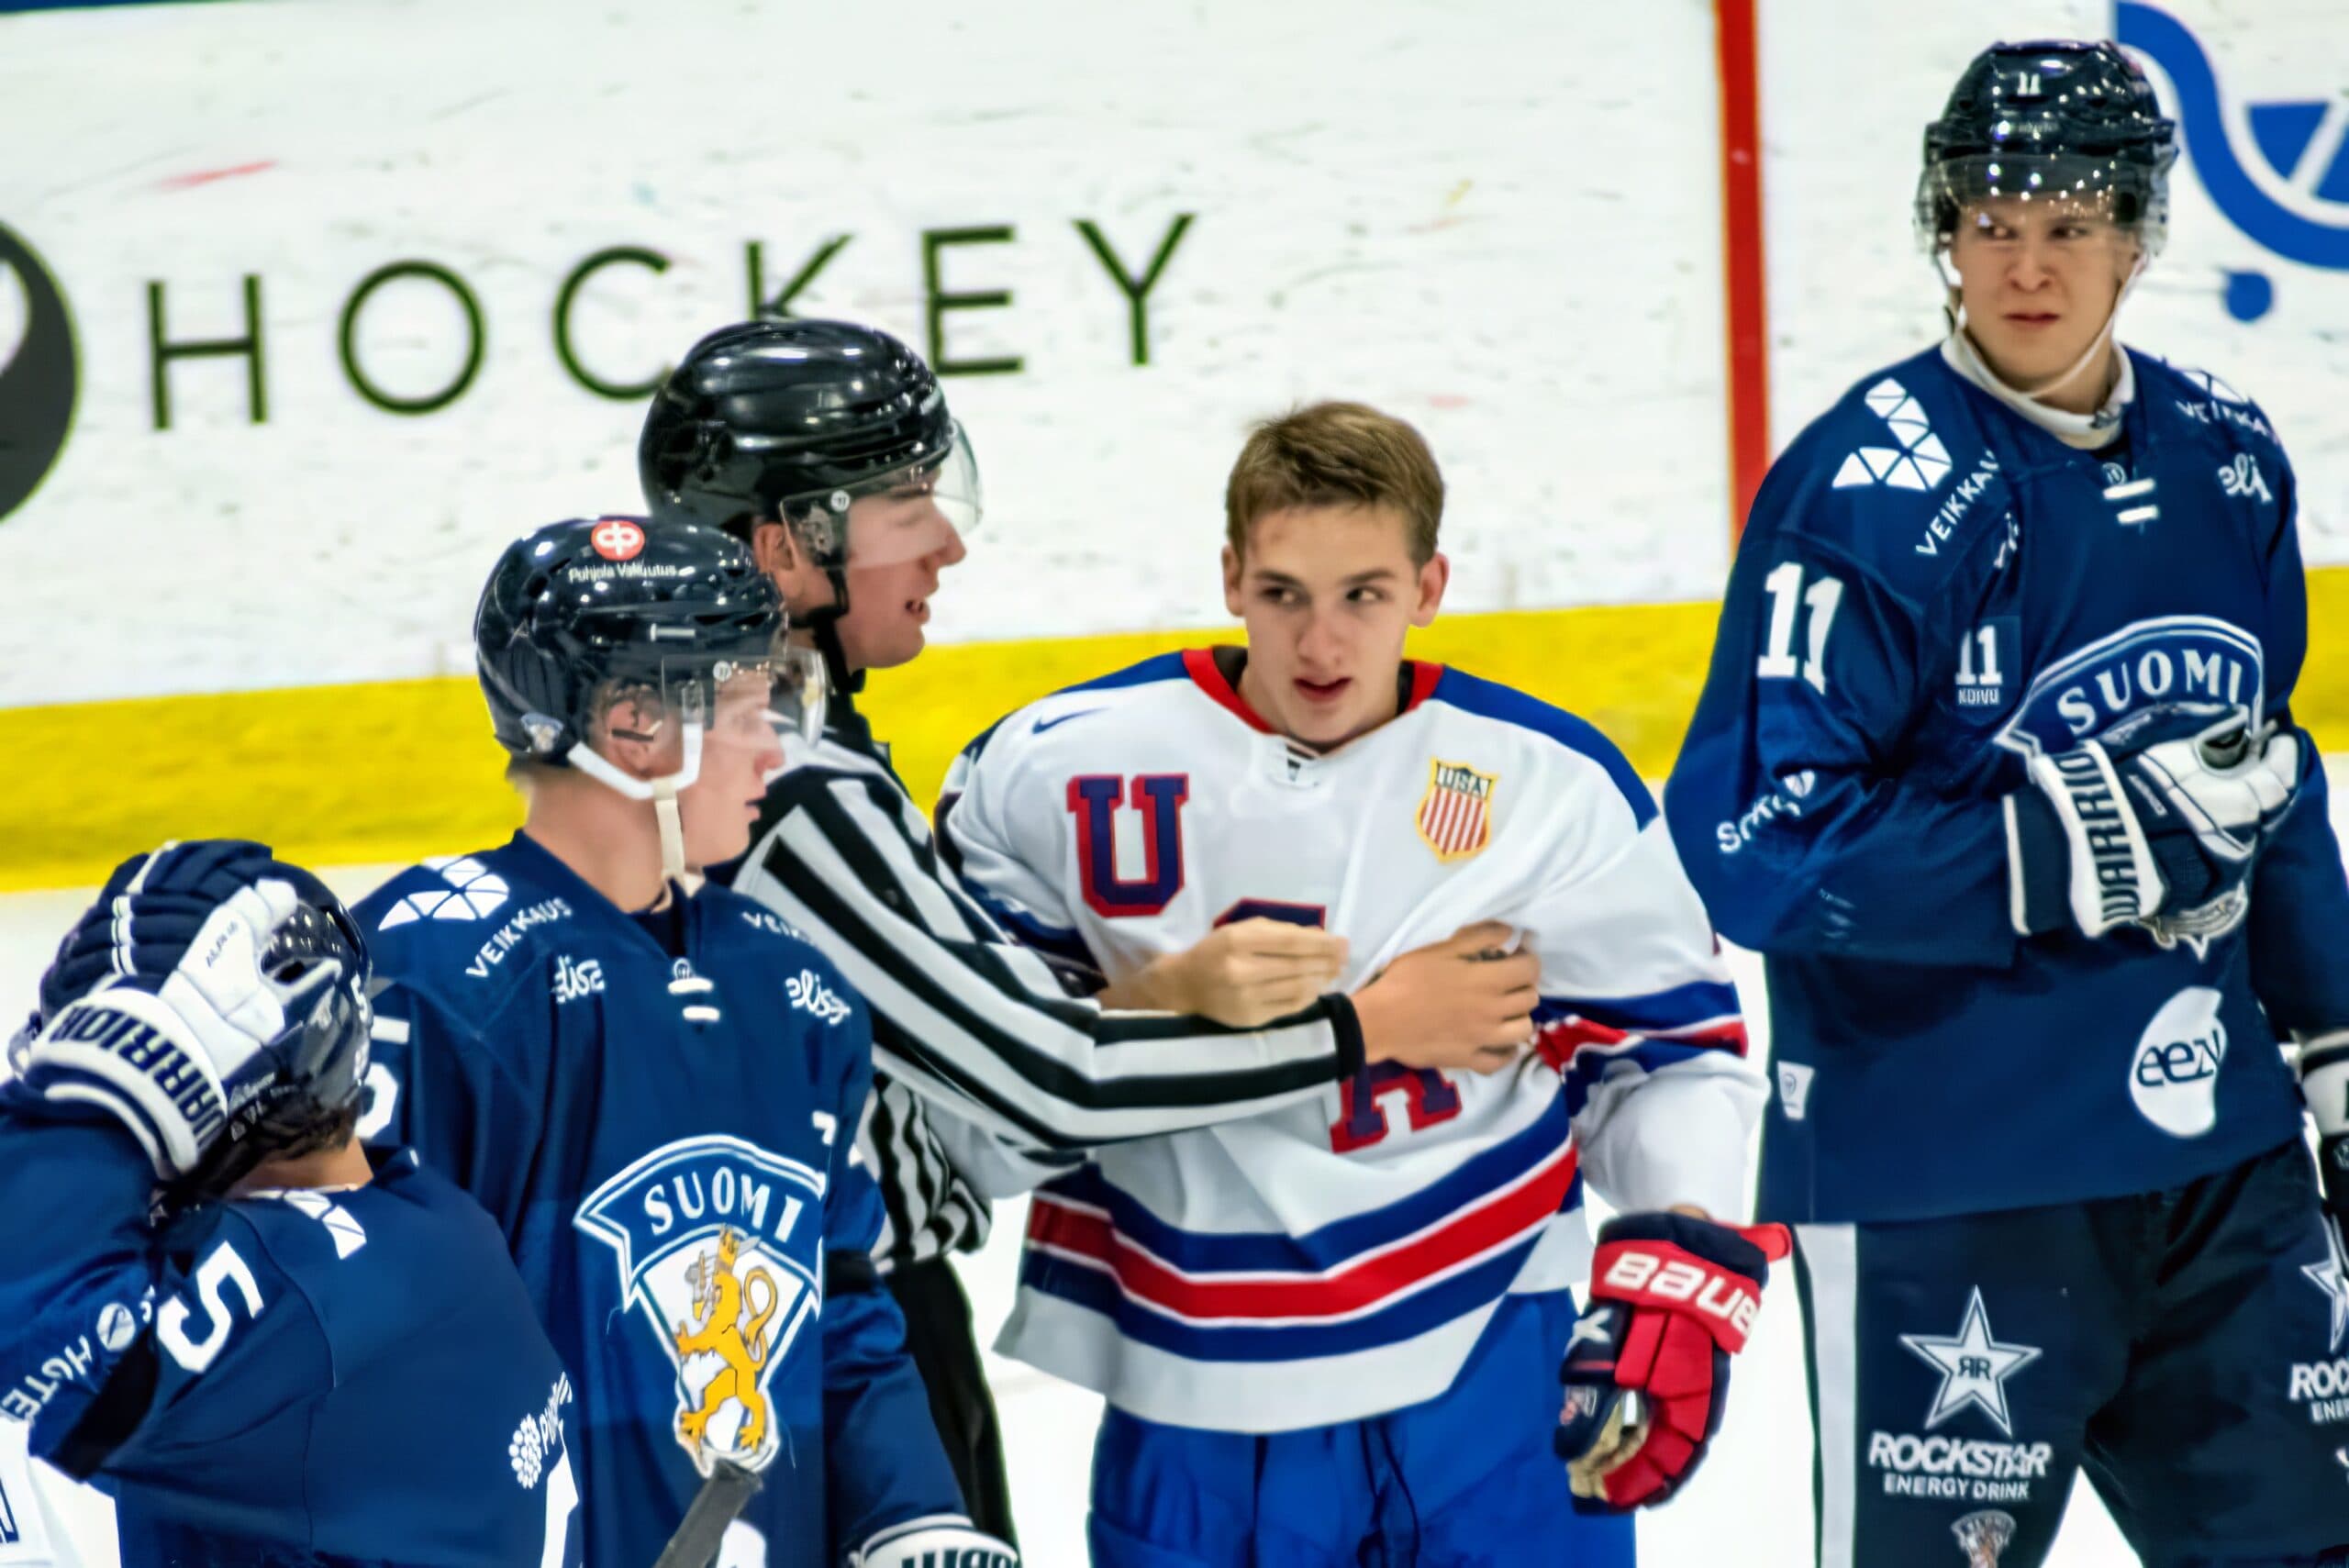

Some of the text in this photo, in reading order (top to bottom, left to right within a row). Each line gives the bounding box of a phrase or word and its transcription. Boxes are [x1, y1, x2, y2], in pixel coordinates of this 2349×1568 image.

[1756, 562, 1843, 696] 11
[1955, 626, 2002, 685] 11
[2056, 649, 2243, 736] SUOMI
[1435, 766, 1490, 798] USA
[466, 896, 573, 978] VEIKKAUS
[644, 1166, 804, 1244] SUOMI
[156, 1240, 264, 1373] 5
[1868, 1430, 2053, 1480] ROCKSTAR
[1883, 1471, 2032, 1502] ENERGY DRINK
